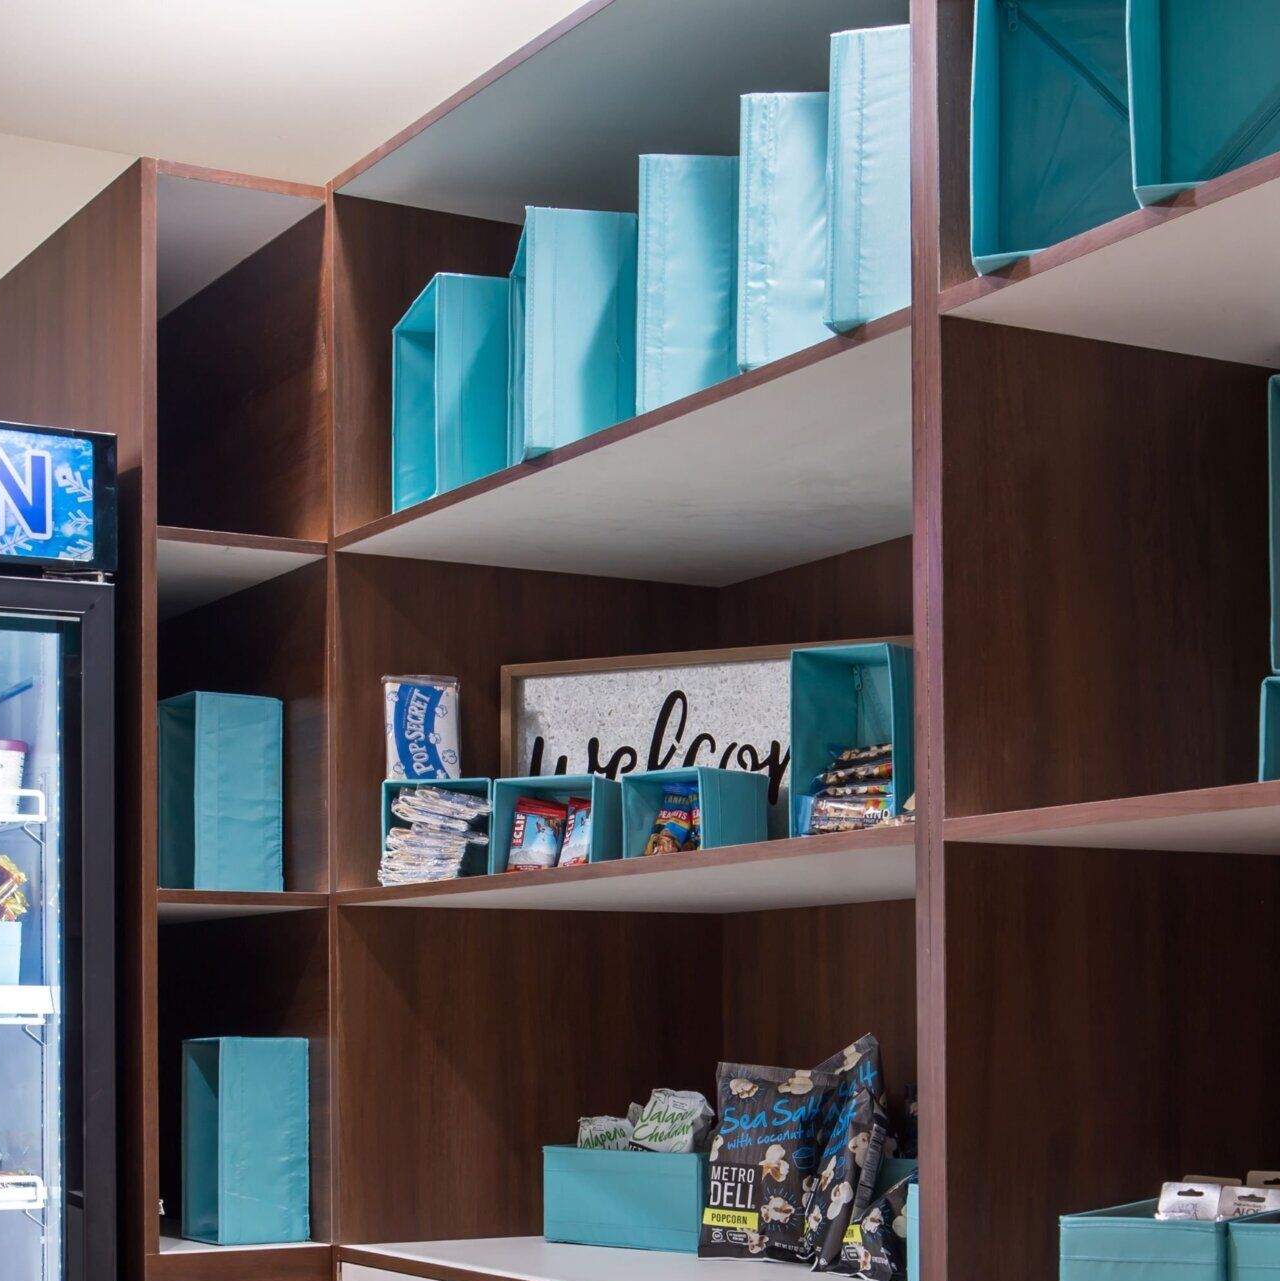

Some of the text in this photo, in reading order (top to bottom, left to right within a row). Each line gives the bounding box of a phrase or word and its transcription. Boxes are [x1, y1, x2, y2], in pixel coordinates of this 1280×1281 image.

[720, 1106, 768, 1135] Sea
[727, 1129, 804, 1151] with coconut
[711, 1166, 755, 1183] METRO
[710, 1181, 753, 1209] DELI
[711, 1213, 748, 1225] POPCORN
